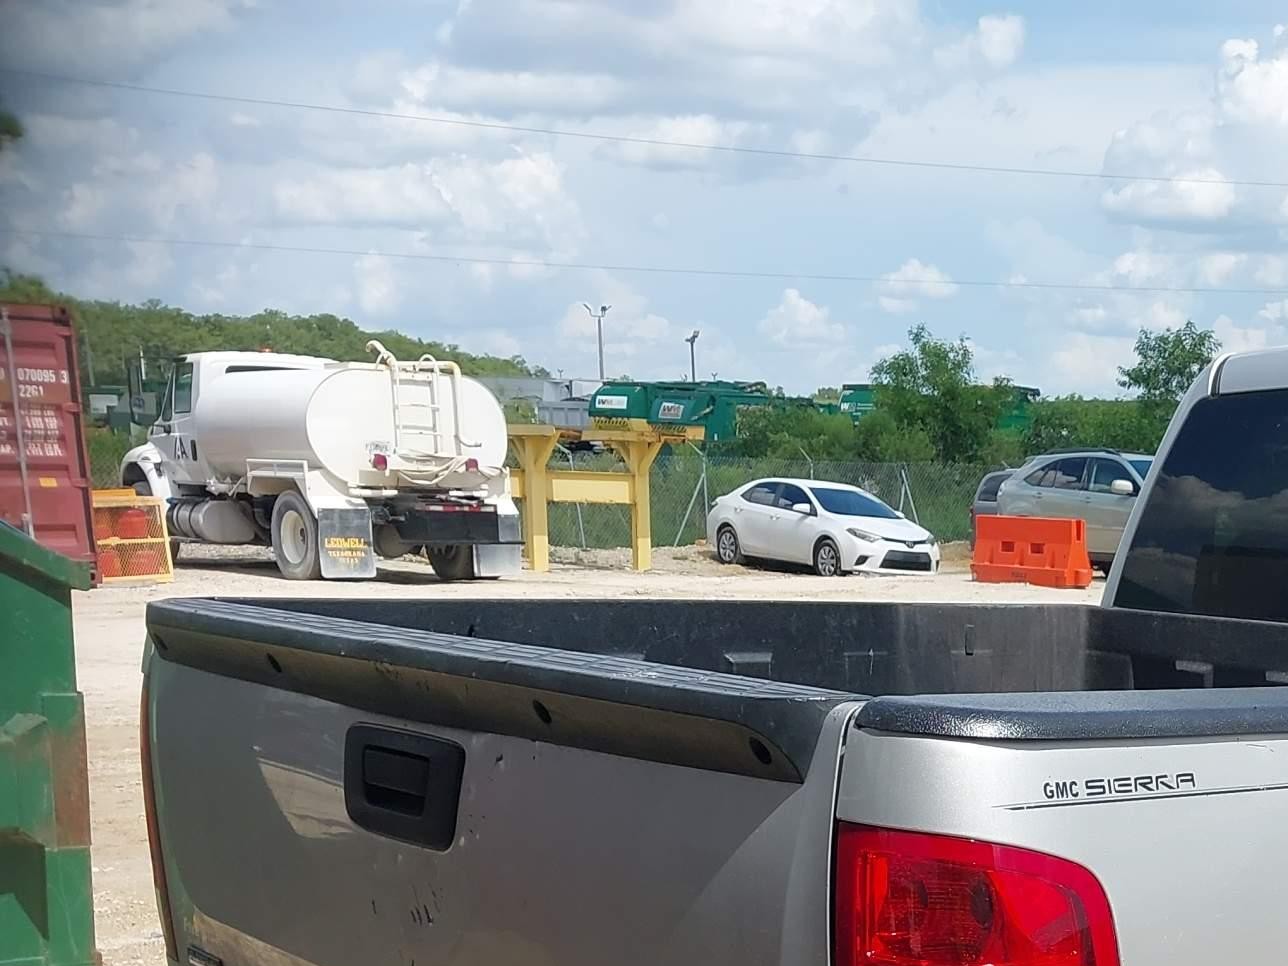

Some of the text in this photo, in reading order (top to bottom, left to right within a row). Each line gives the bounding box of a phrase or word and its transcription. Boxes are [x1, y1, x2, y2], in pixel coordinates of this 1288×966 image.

[17, 368, 56, 383] 070095
[325, 537, 368, 548] LEDWELL
[1043, 772, 1196, 799] GMC SIERRA
